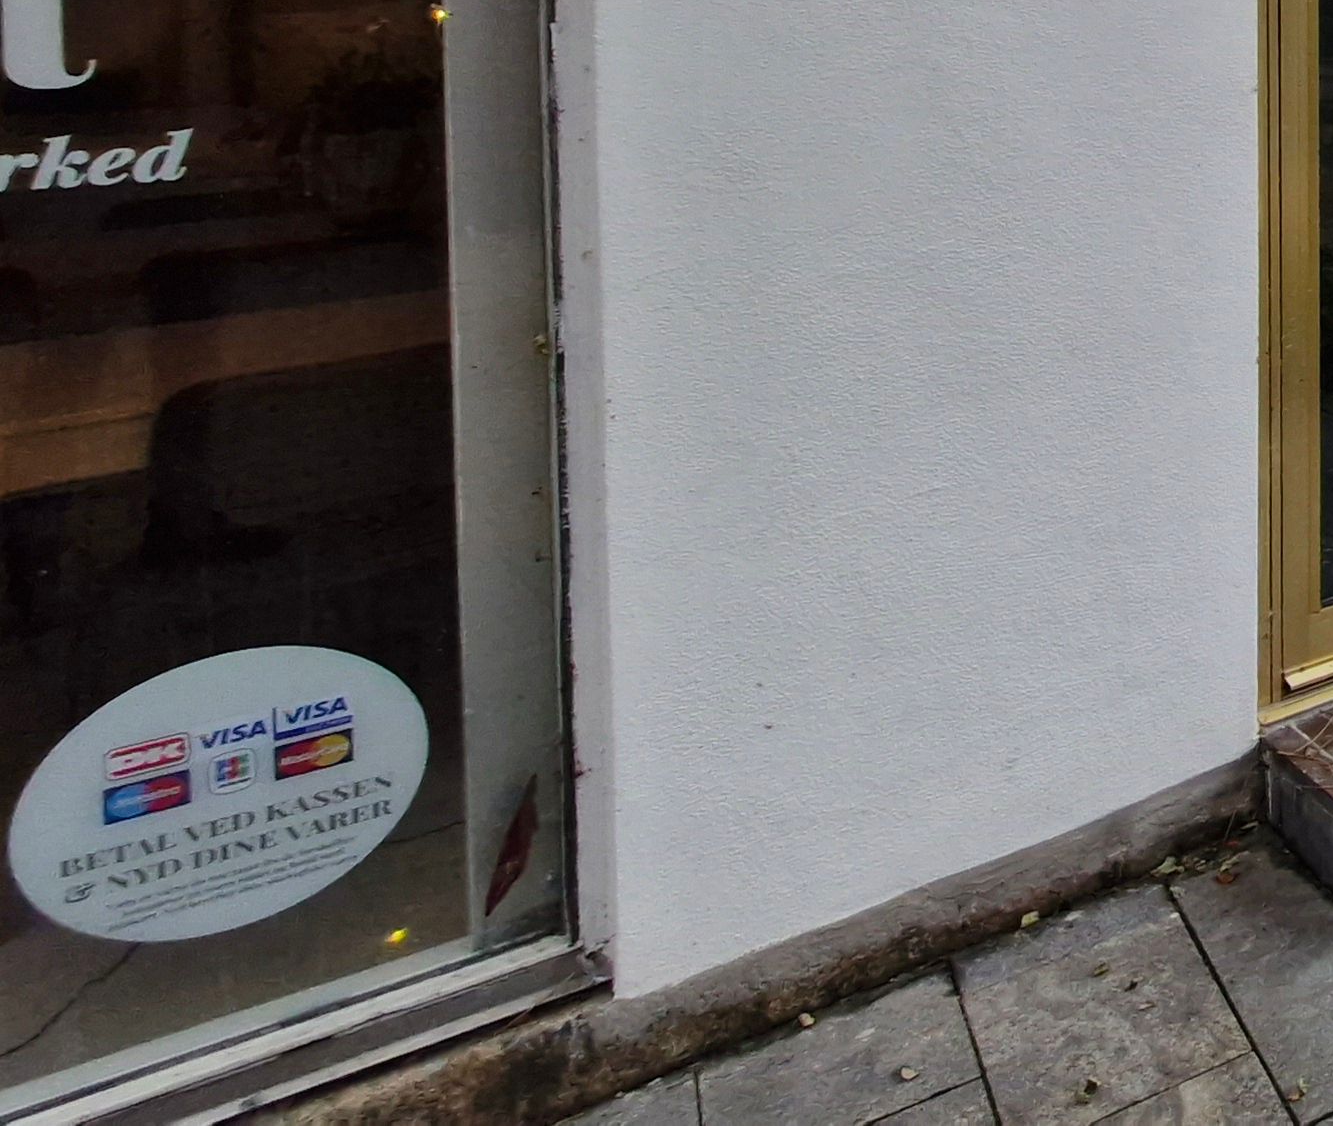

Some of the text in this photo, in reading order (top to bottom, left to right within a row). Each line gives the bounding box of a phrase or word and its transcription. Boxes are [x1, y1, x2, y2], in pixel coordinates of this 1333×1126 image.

[200, 720, 267, 749] VISA
[283, 697, 348, 724] VISA
[57, 776, 393, 878] BETAL VED KASSEN
[189, 829, 279, 870] DINE
[285, 799, 394, 841] VARER
